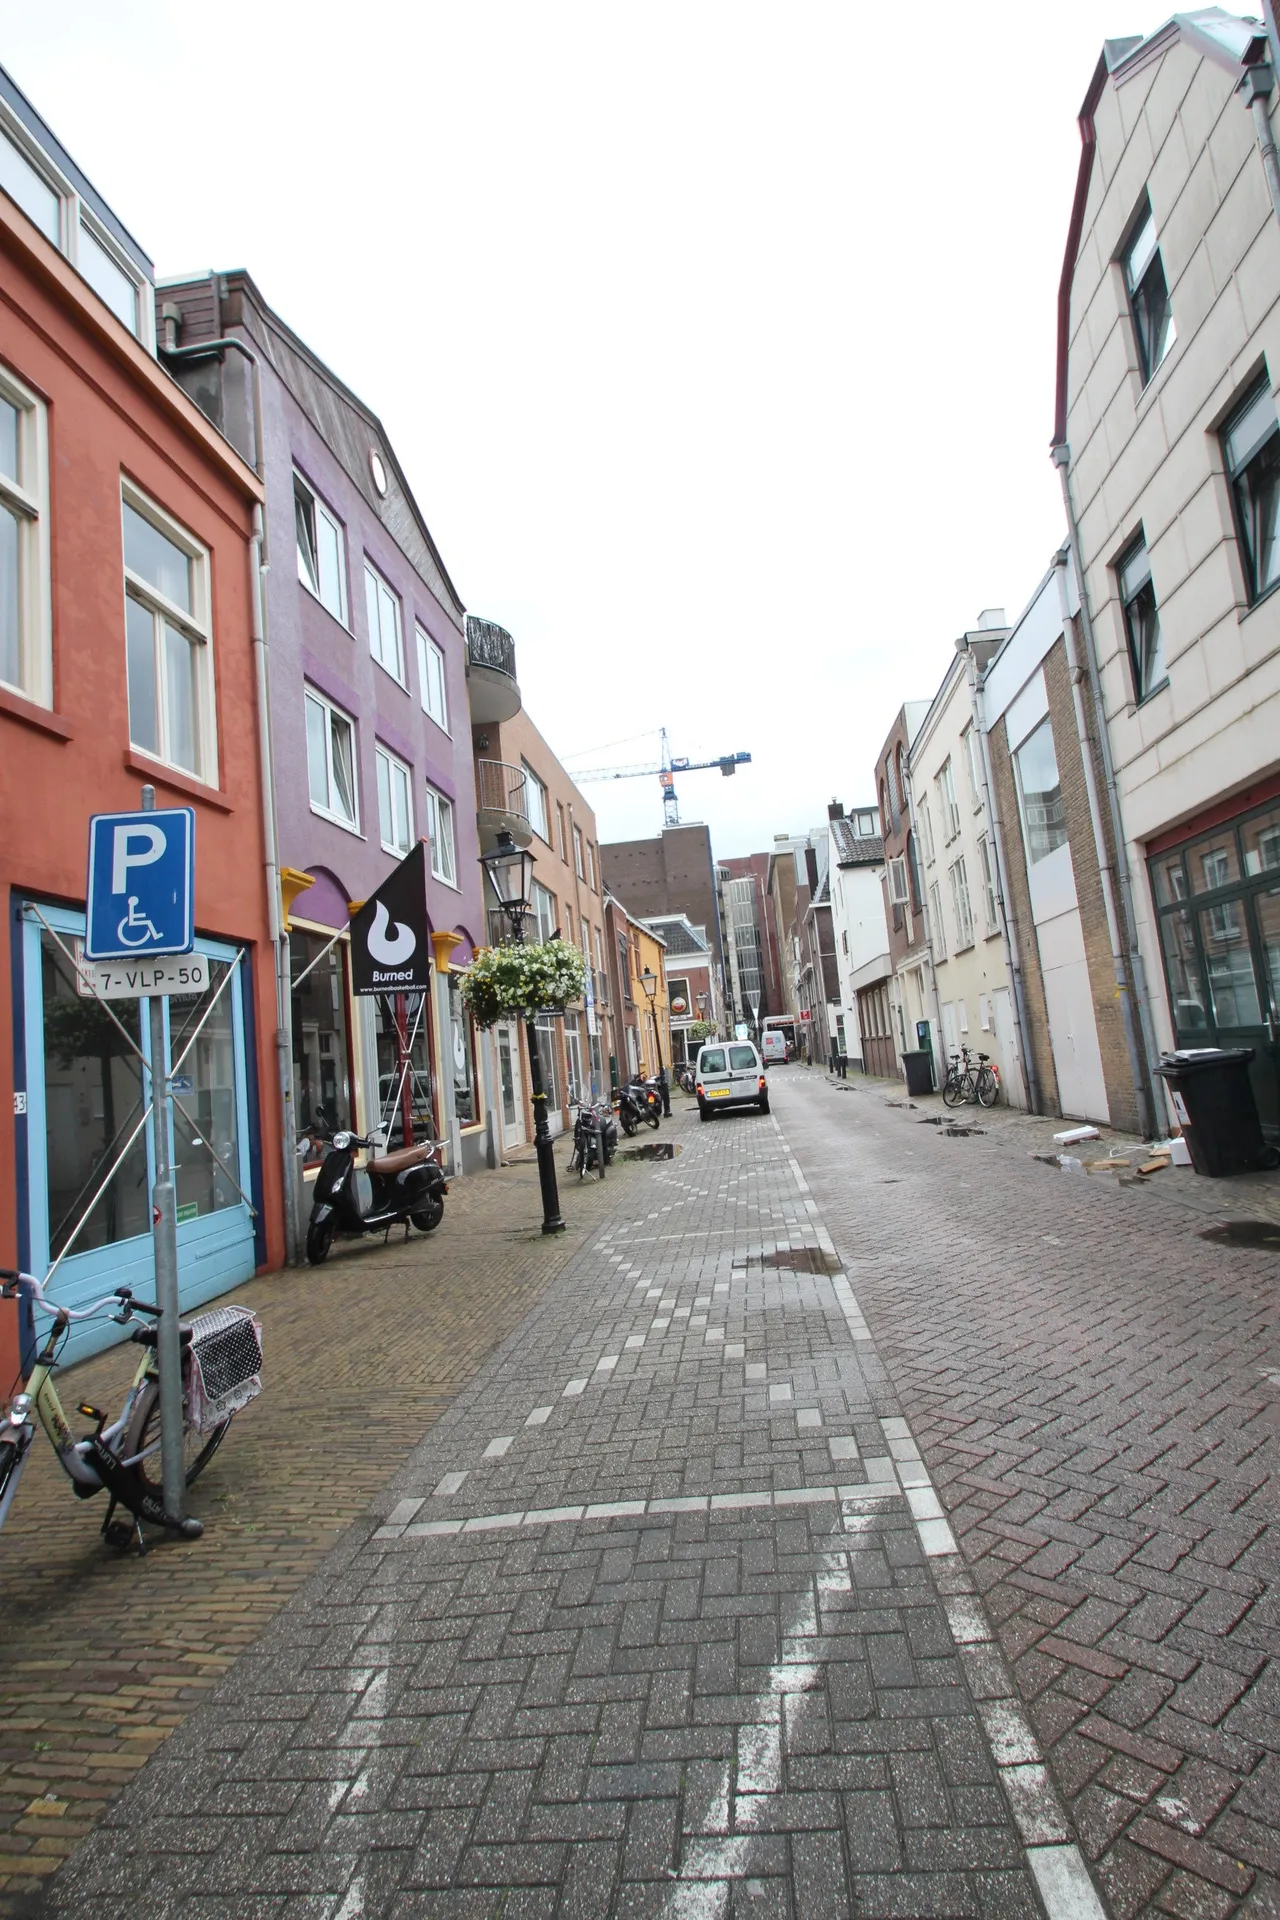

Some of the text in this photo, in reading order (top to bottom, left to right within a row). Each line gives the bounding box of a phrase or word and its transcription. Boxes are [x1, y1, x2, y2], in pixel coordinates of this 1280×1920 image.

[112, 823, 167, 895] P
[100, 967, 203, 990] 7-VLP-50
[372, 968, 413, 982] Burned
[360, 984, 427, 992] www.burnedbasketball.com
